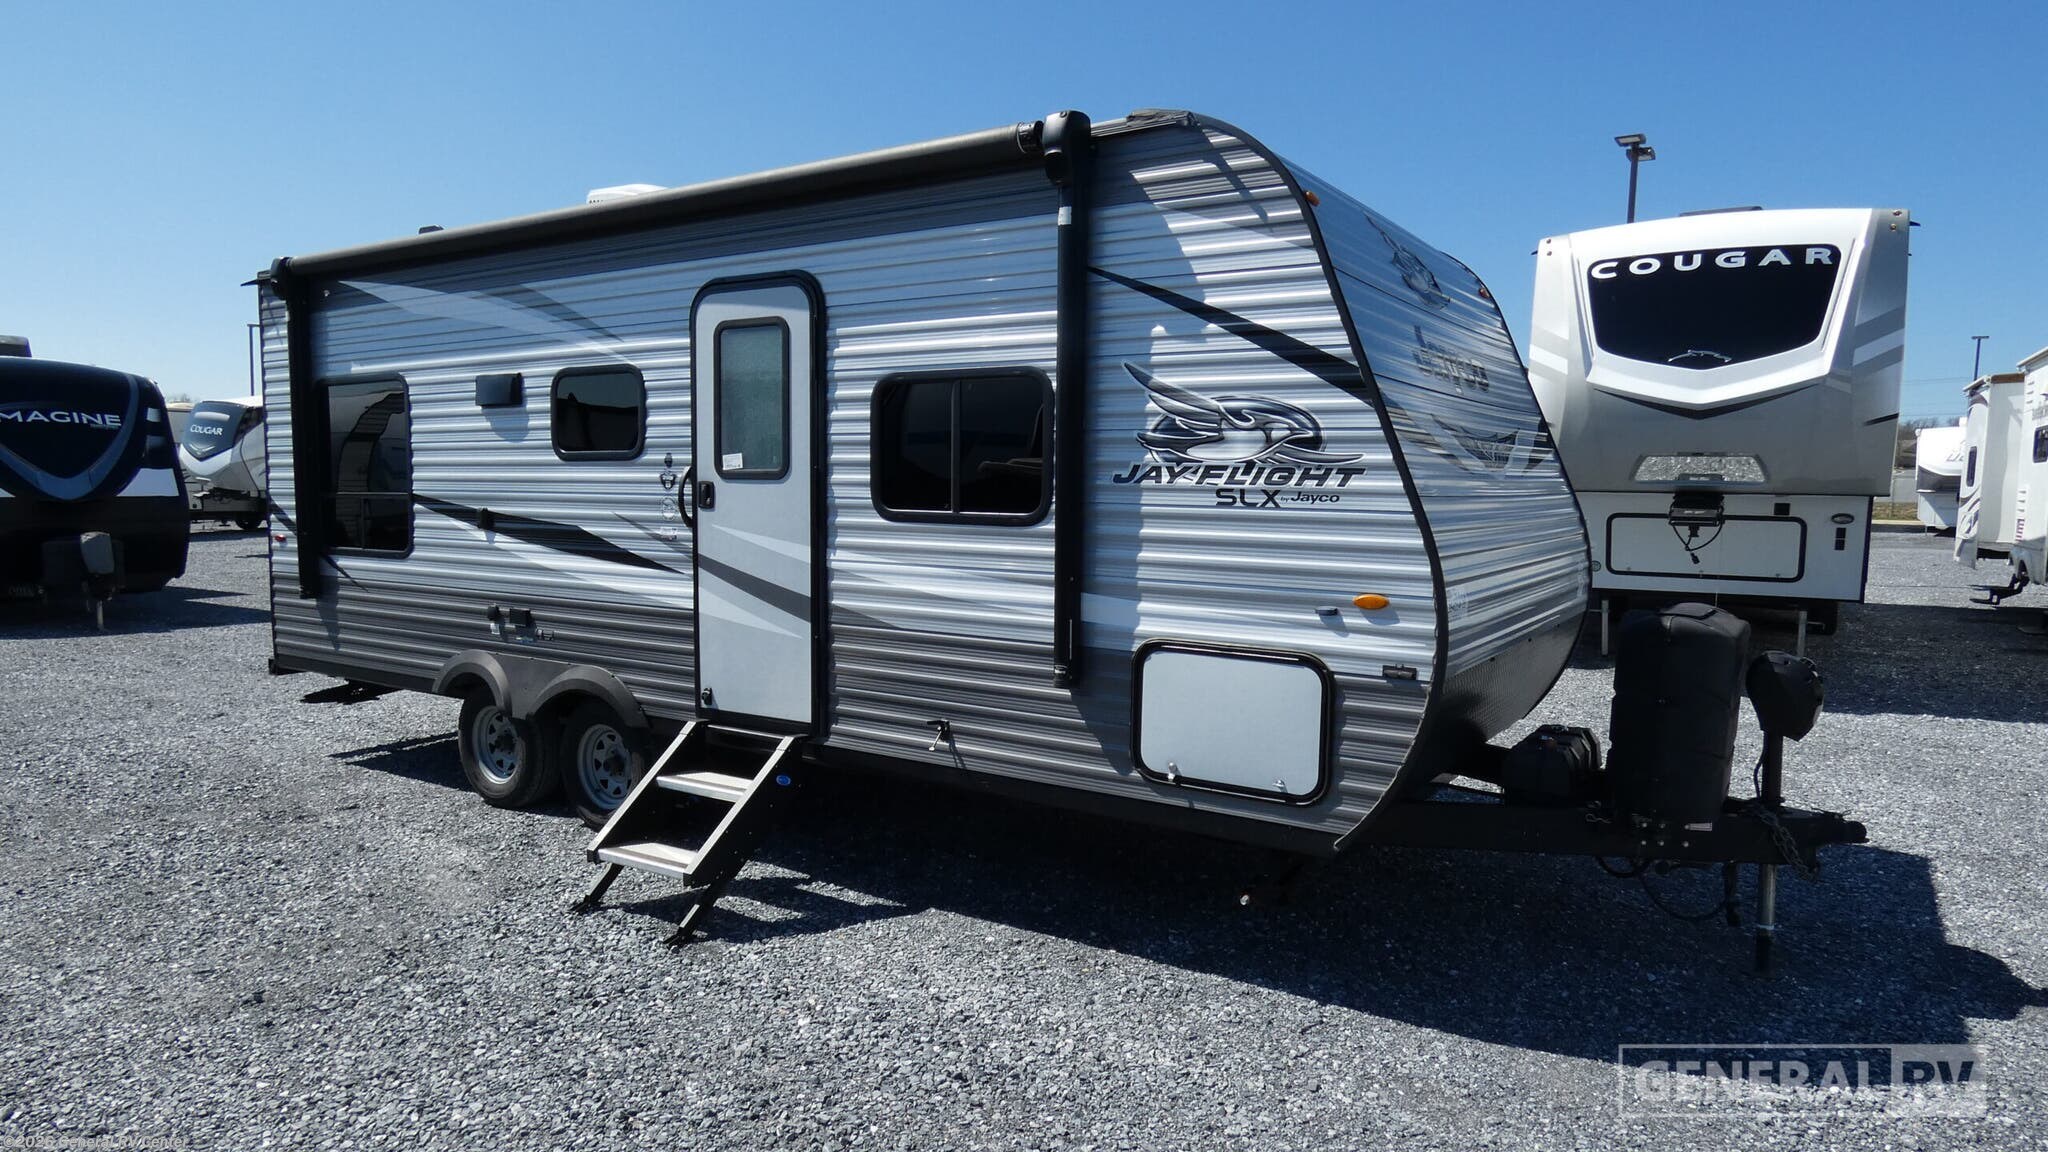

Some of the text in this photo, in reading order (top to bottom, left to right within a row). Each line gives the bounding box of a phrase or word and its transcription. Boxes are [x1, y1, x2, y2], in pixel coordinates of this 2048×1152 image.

[1590, 247, 1834, 280] COUGAR
[190, 424, 223, 436] COUGAR
[1215, 488, 1281, 508] SLX
[1291, 491, 1340, 504] Jayco
